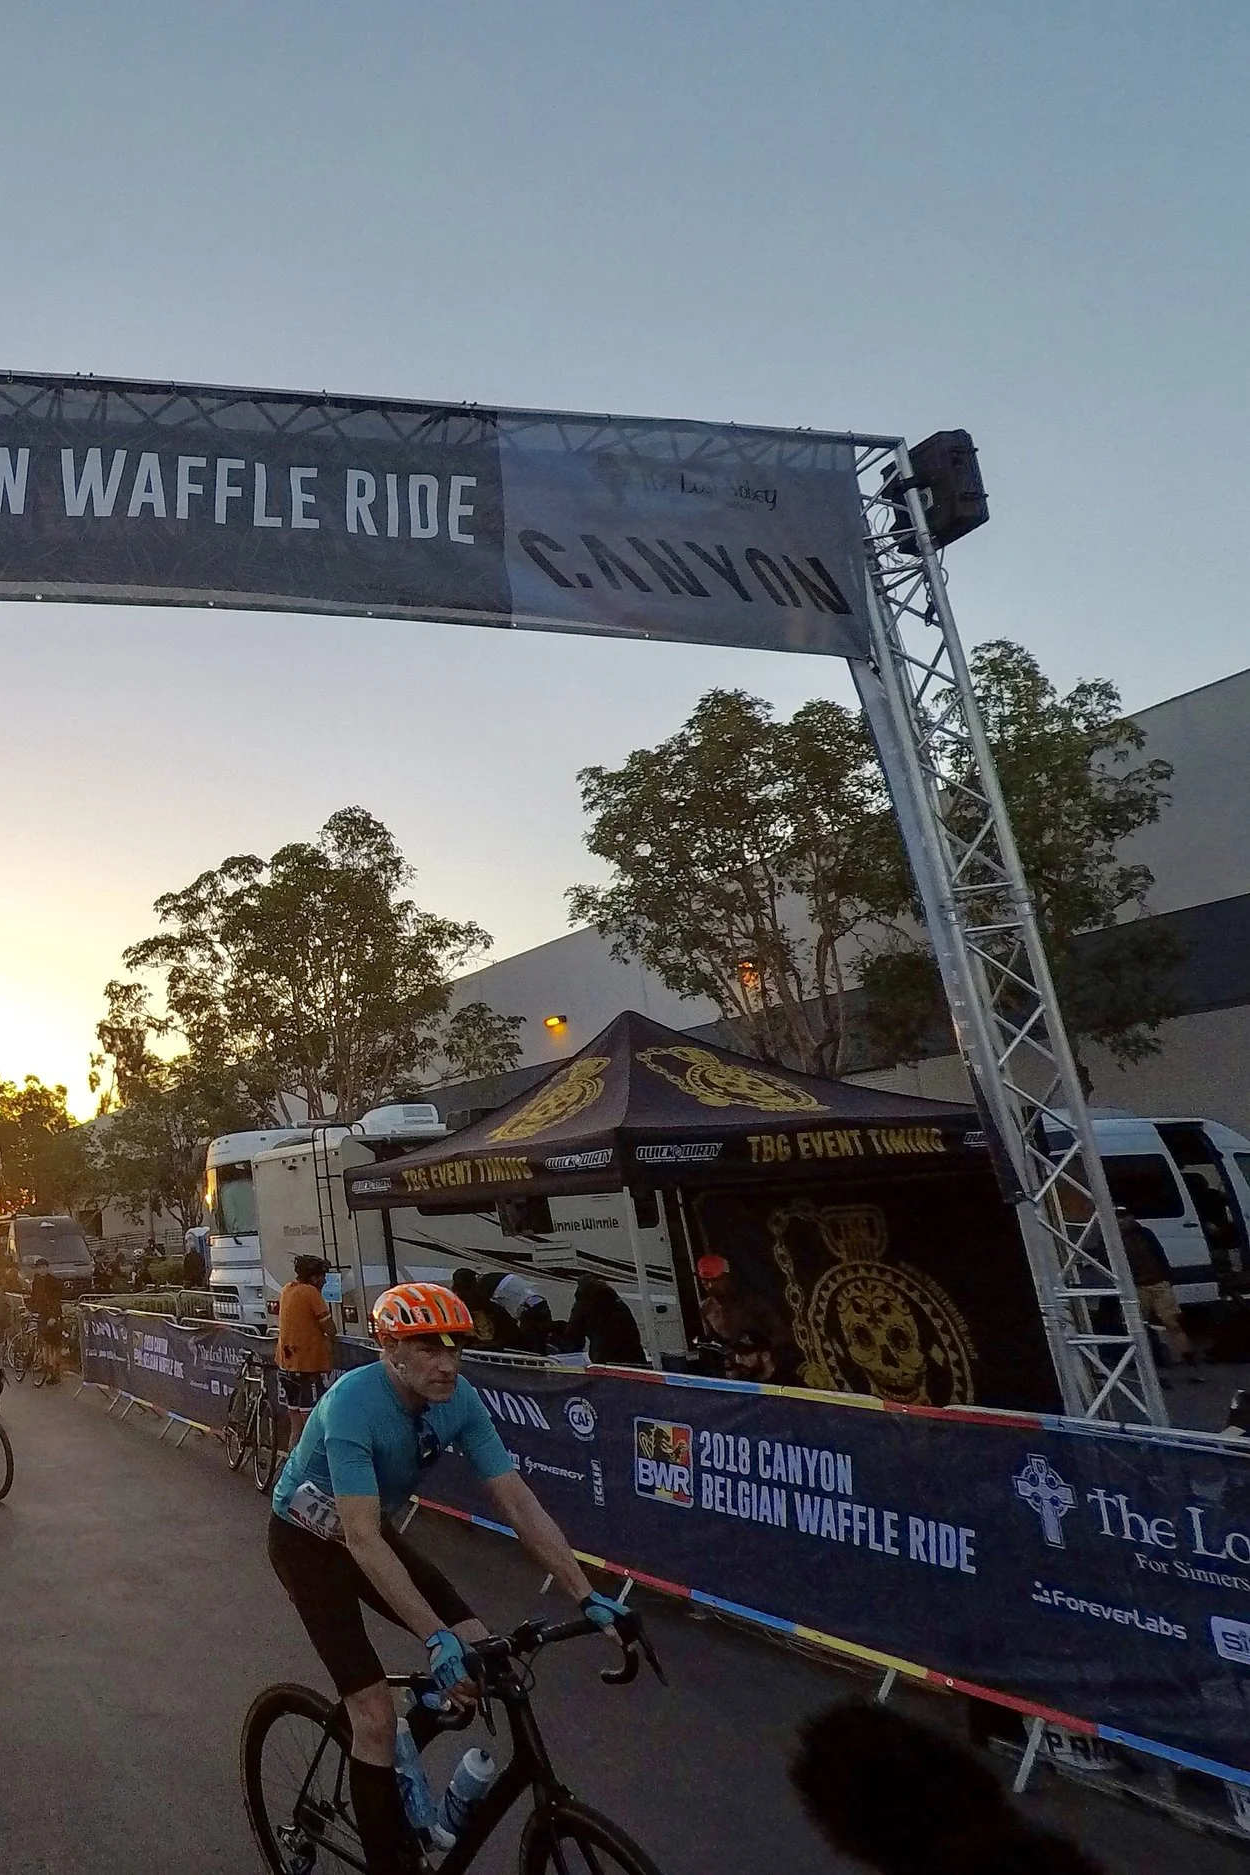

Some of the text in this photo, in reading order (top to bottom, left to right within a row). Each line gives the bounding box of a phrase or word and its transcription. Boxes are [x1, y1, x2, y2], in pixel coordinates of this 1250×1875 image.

[60, 447, 320, 530] WAFFLE
[344, 469, 478, 545] RIDE
[517, 528, 853, 615] CANYON
[747, 1127, 947, 1163] TBG EVENT TIMING
[401, 1168, 430, 1193] TBG
[431, 1161, 472, 1189] EVENT
[477, 1156, 535, 1184] TIMING
[553, 1216, 620, 1232] innie Winnie
[472, 1384, 551, 1431] YON
[636, 1457, 694, 1497] BWR
[699, 1430, 854, 1496] 2018 CANYON
[700, 1472, 978, 1575] BELGIAN WAFFLE RIDE
[1086, 1487, 1178, 1550] The
[1133, 1552, 1250, 1592] For Sinners
